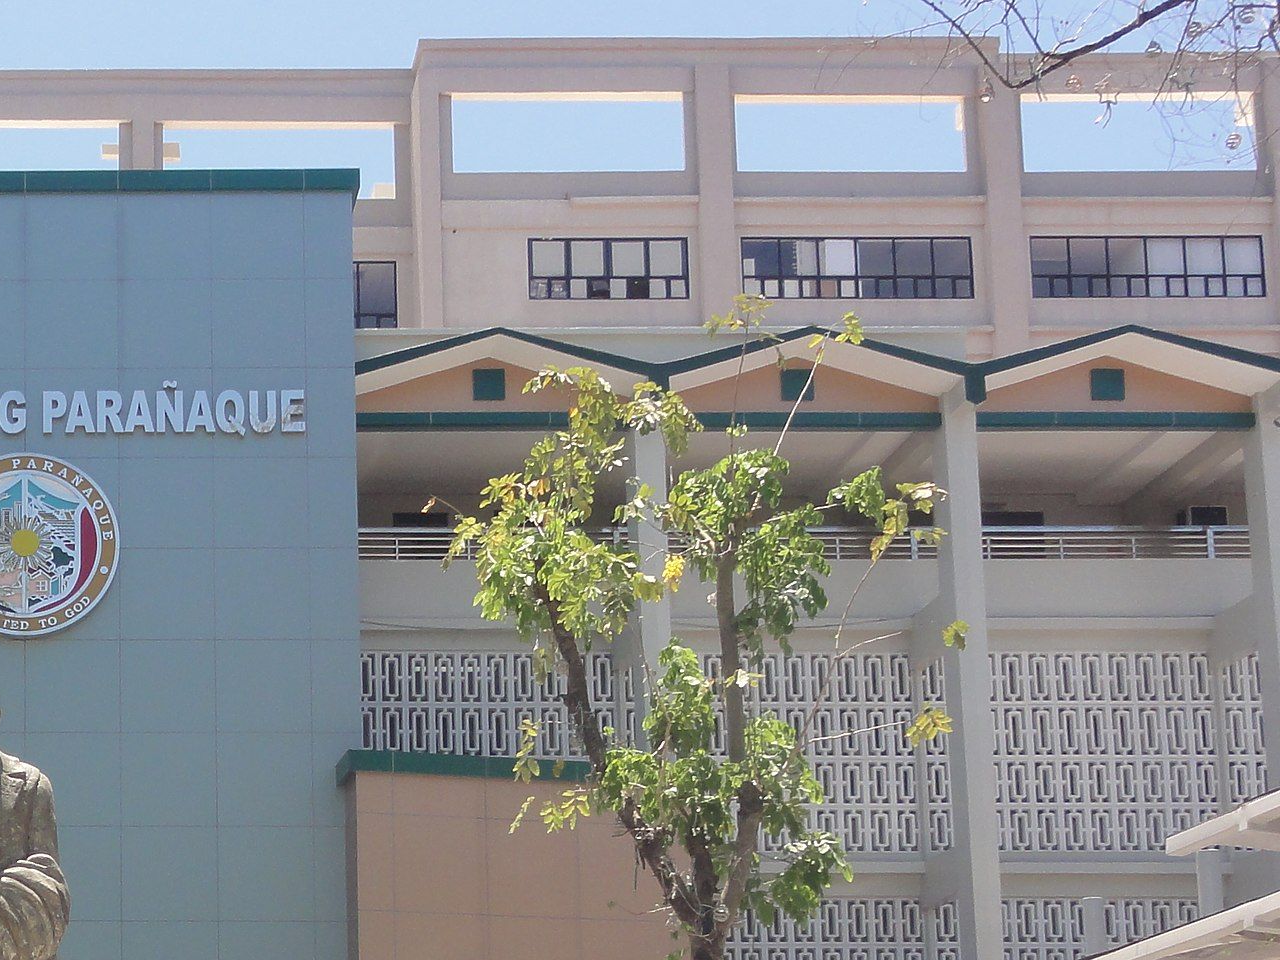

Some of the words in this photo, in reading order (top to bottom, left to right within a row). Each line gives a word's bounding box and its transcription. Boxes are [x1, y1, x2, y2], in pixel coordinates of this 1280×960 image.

[42, 380, 307, 436] PARAÑAQUE
[38, 616, 58, 629] TO
[64, 596, 92, 618] GOD
